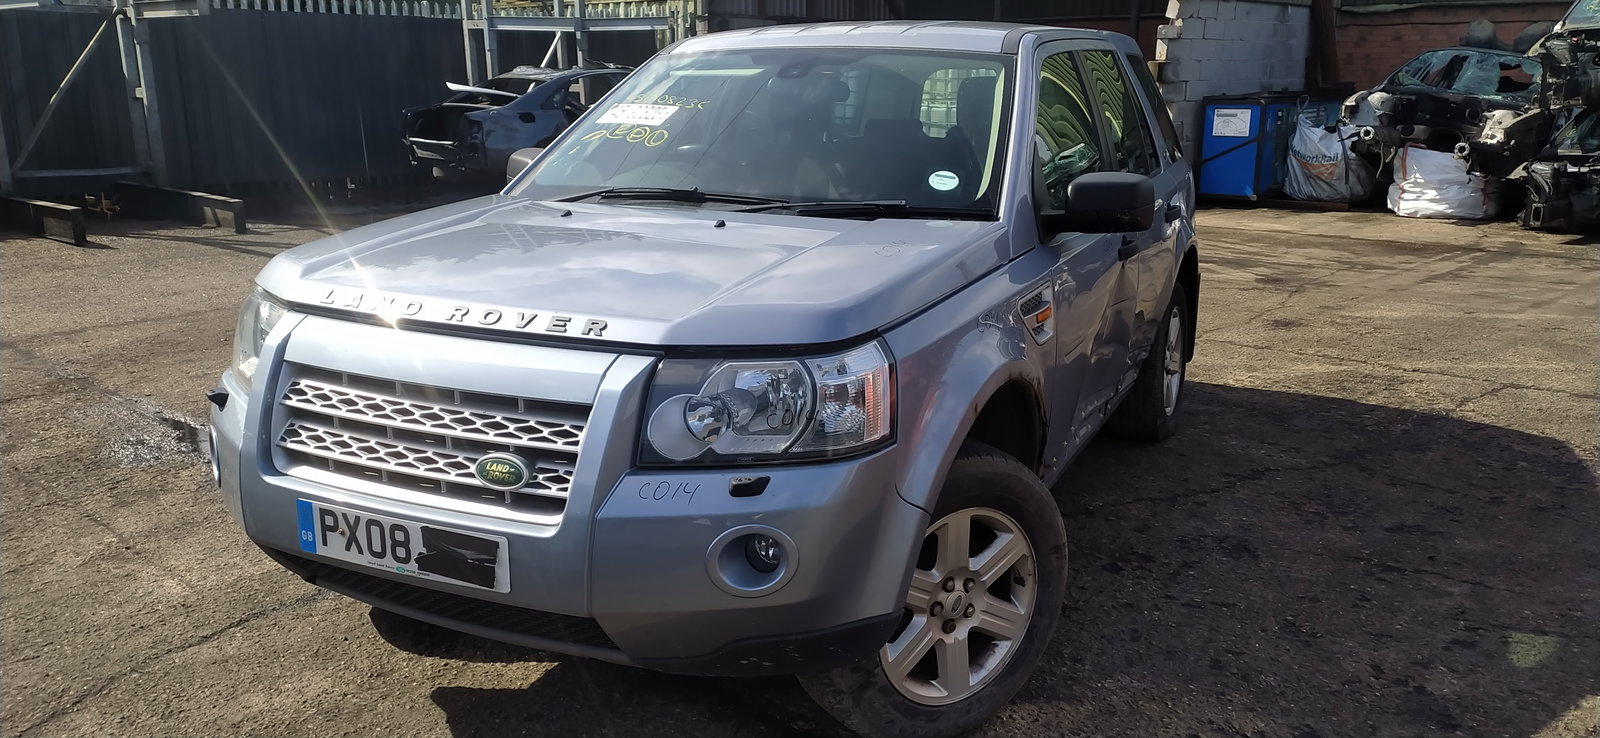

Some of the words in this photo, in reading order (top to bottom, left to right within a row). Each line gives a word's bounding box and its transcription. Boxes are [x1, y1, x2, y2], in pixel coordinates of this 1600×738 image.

[445, 305, 608, 337] ROVER
[301, 529, 313, 542] GB
[319, 507, 412, 565] PX08
